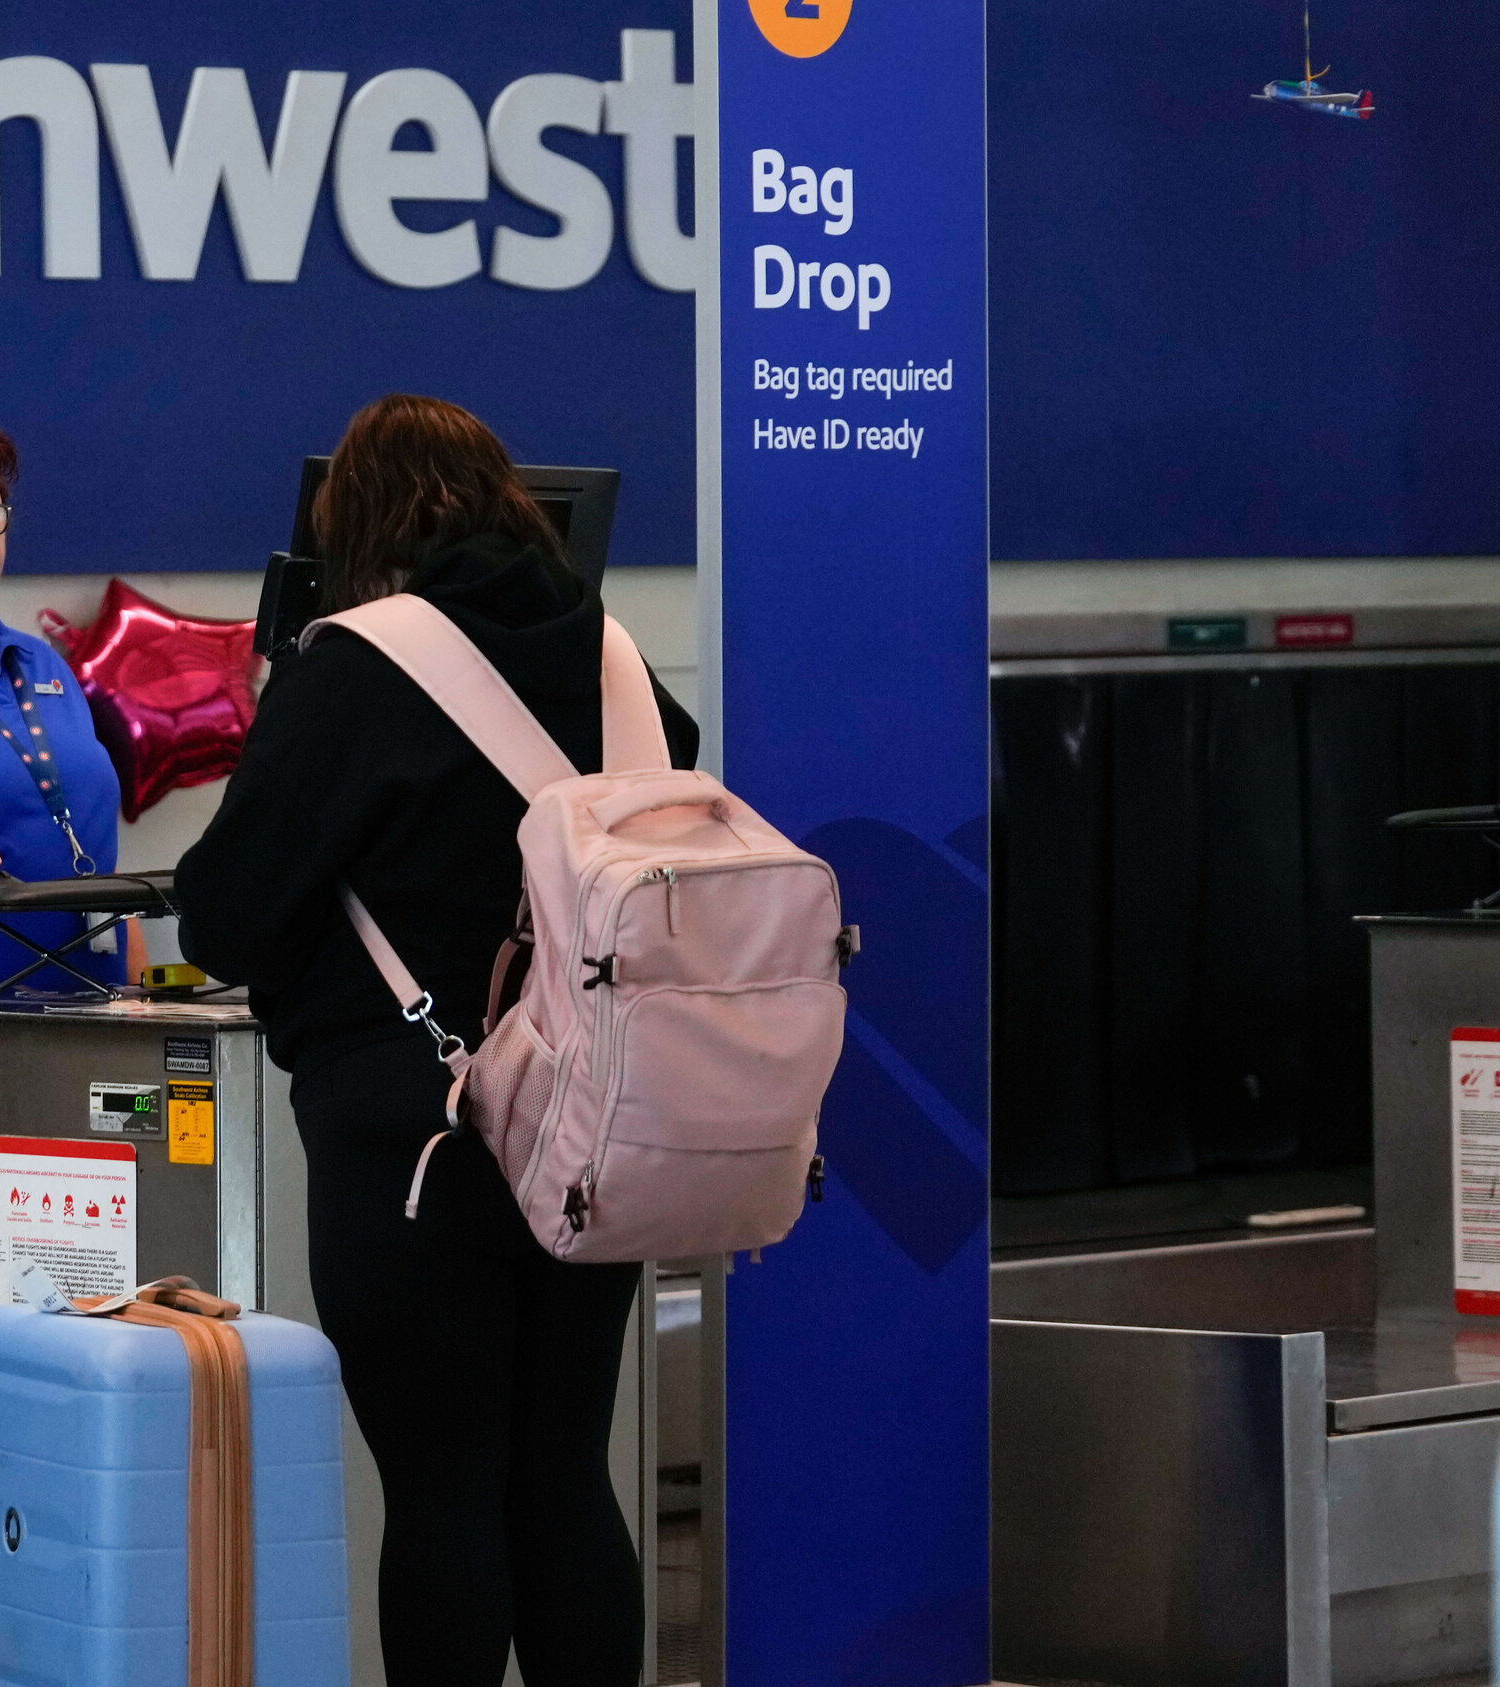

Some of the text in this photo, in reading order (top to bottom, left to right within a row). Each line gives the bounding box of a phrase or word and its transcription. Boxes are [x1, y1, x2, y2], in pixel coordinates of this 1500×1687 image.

[752, 148, 854, 236] Bag
[753, 244, 891, 331] Drop
[754, 358, 953, 400] Bag tag required
[754, 418, 925, 459] Have ID ready
